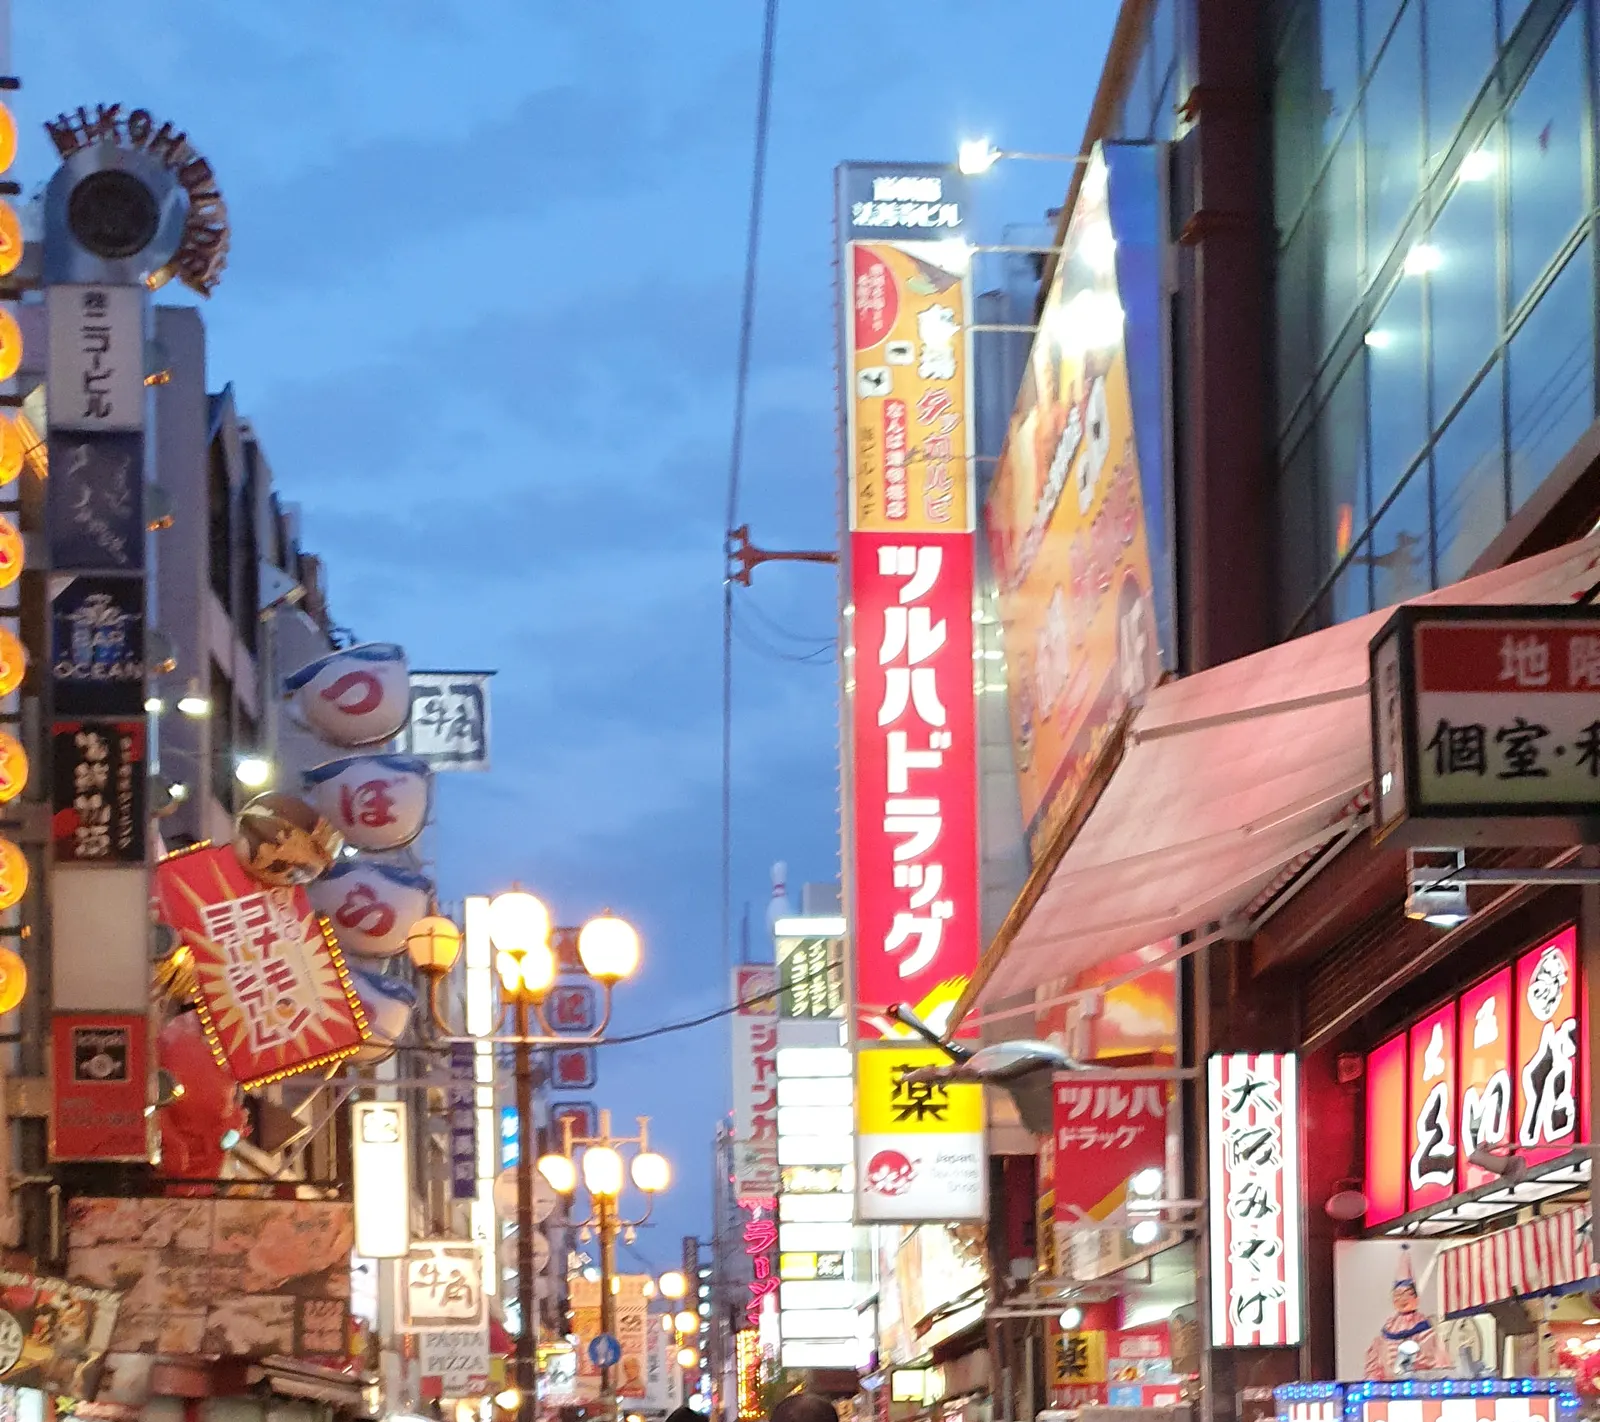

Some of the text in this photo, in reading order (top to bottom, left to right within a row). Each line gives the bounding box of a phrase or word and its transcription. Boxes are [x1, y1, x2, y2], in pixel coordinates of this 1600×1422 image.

[877, 545, 953, 978] ツルハドラッグ
[890, 1064, 950, 1123] 薬
[1057, 1085, 1164, 1120] ツルハ
[1058, 1125, 1144, 1150] ドラッグ
[1230, 1077, 1285, 1325] 大阪みやげ
[410, 1263, 474, 1310] 牛角
[428, 1356, 485, 1372] PIZZA
